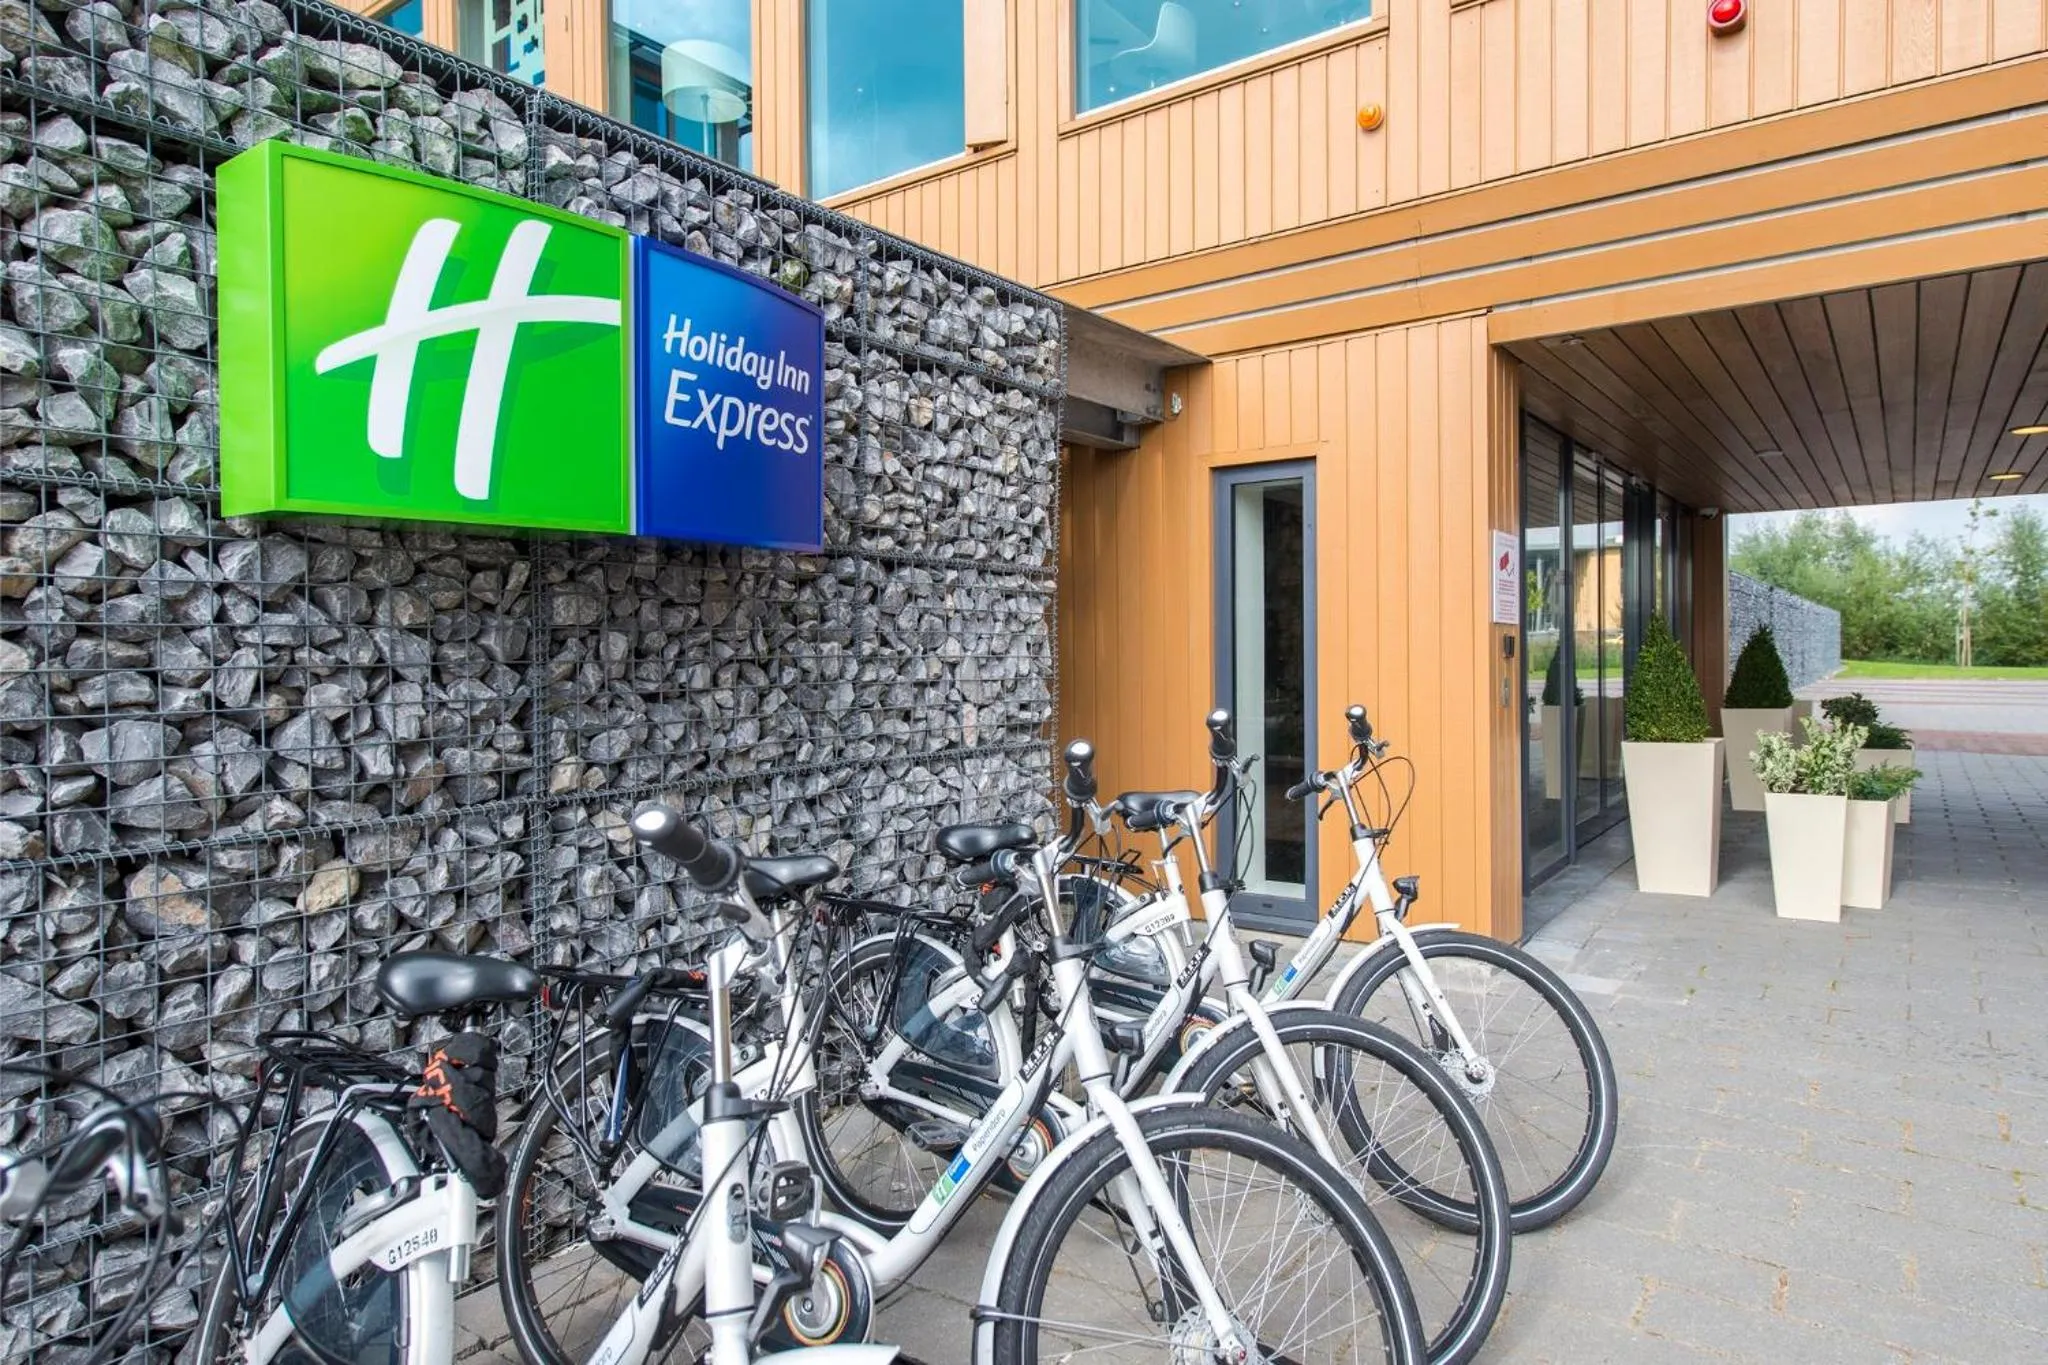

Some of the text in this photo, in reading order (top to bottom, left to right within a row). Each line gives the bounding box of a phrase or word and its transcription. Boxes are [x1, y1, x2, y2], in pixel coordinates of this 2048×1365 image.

[315, 218, 622, 501] H
[662, 313, 811, 395] Holiday Inn
[664, 368, 810, 455] Express
